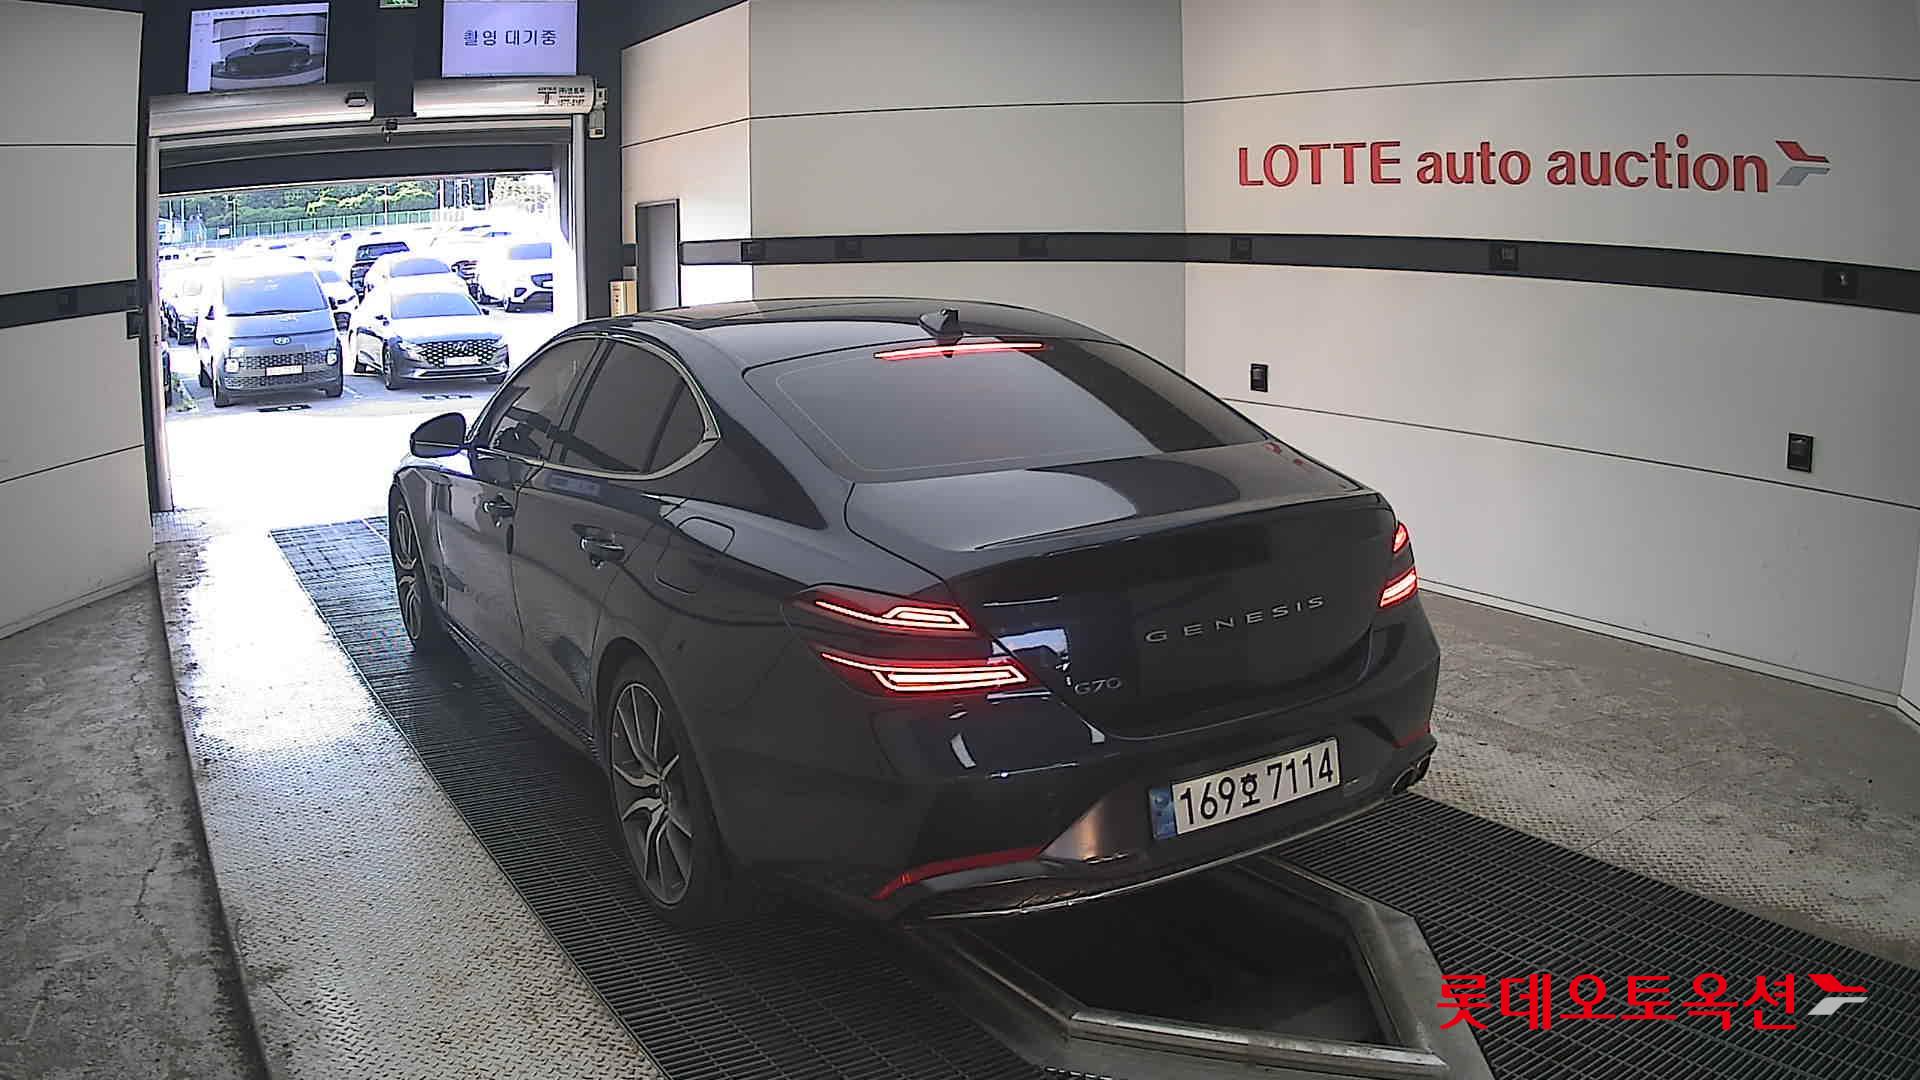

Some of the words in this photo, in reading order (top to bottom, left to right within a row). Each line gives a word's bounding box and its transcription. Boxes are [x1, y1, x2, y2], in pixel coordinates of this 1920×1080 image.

[504, 29, 557, 47] 대기중
[1238, 140, 1401, 187] LOTTE
[1415, 140, 1532, 186] auto
[1546, 134, 1769, 193] auction
[1145, 595, 1325, 643] GENESIS
[1074, 676, 1124, 696] G70
[1179, 772, 1262, 825] 169호
[1266, 747, 1334, 801] 7114
